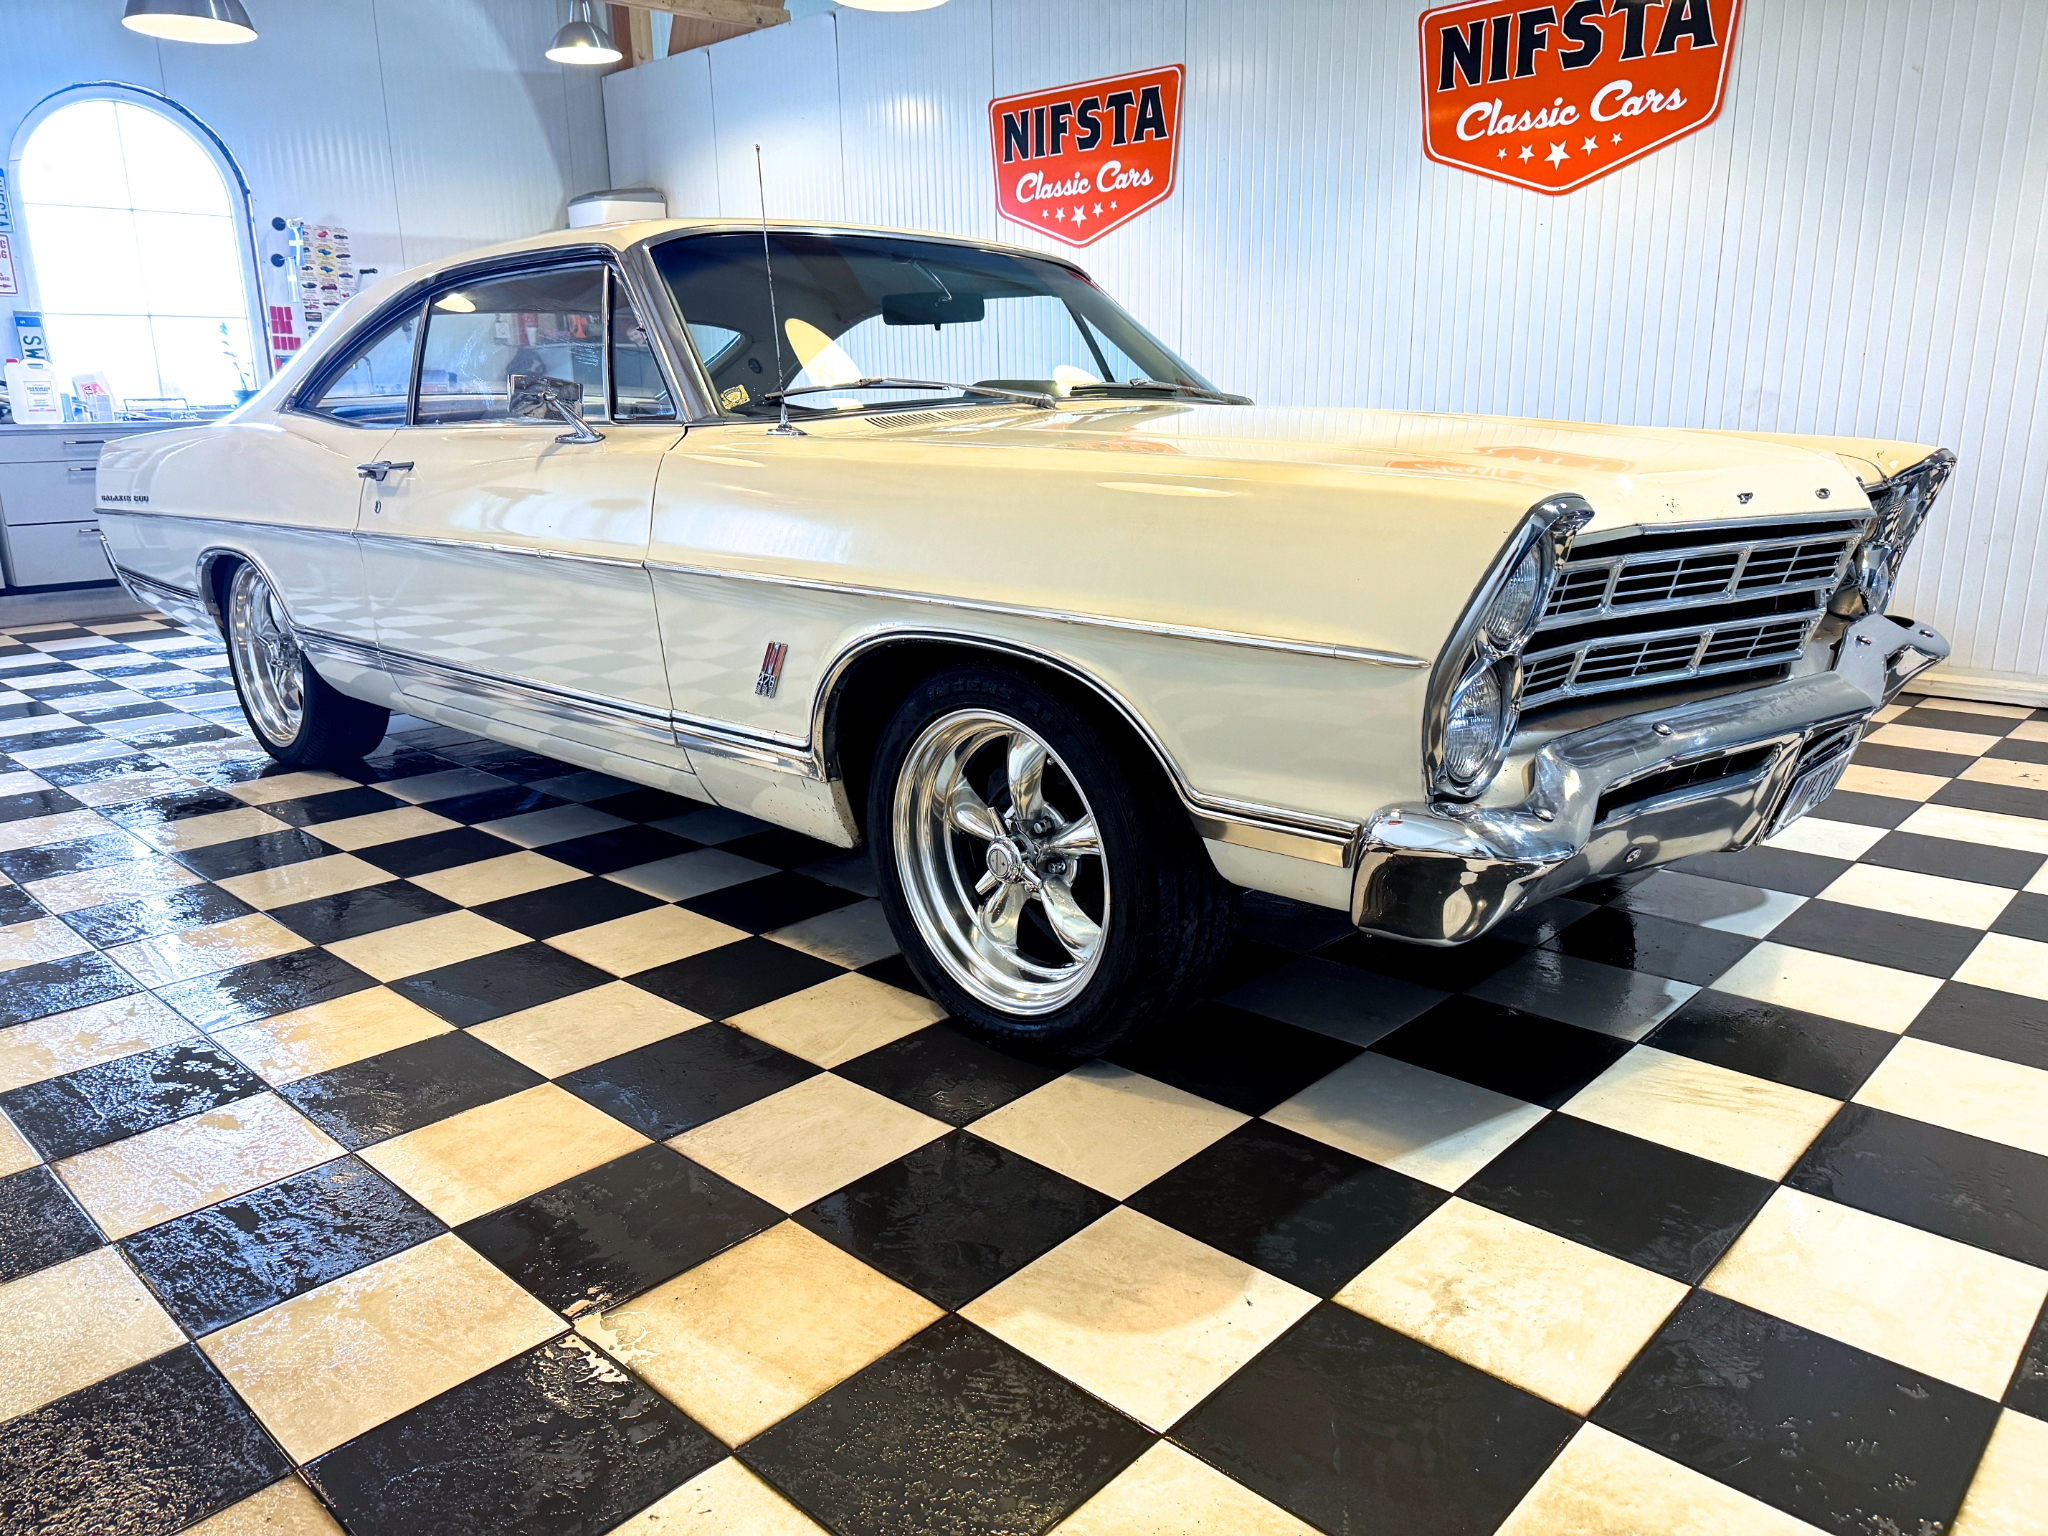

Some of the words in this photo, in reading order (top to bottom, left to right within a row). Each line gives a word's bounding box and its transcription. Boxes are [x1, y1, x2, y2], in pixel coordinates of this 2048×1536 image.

[1437, 0, 1718, 92] NIFSTA
[1001, 84, 1170, 164] NIFSTA
[1455, 96, 1580, 141] Classic
[1589, 79, 1687, 122] Cars
[1015, 169, 1091, 203] Classic
[1096, 160, 1154, 192] Cars
